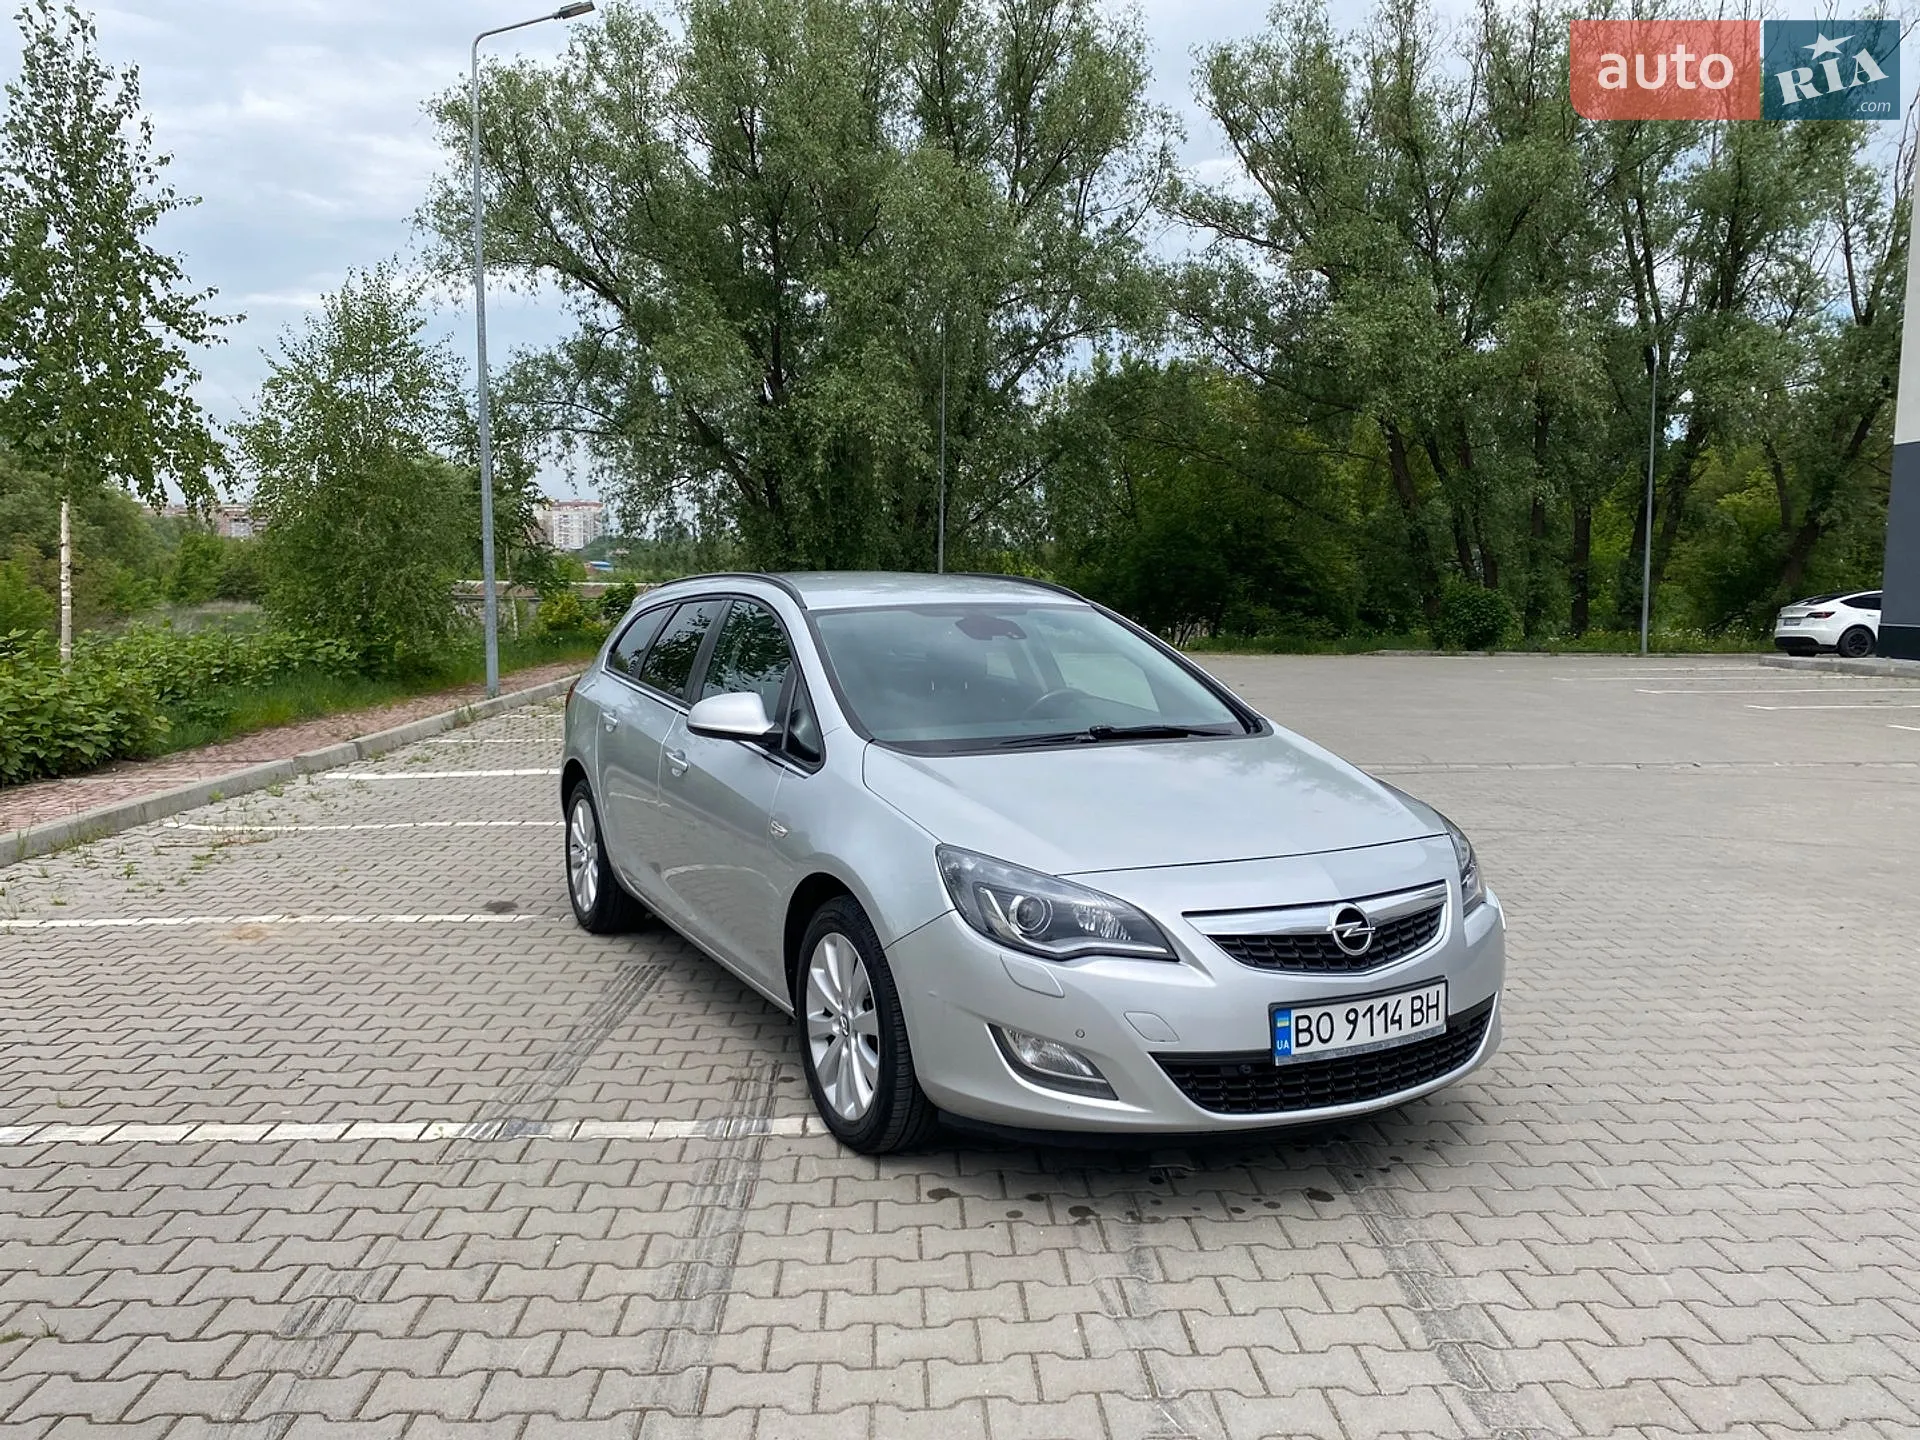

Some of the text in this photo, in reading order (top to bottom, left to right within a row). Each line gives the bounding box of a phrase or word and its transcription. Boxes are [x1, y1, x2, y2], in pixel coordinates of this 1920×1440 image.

[1295, 990, 1440, 1048] BO 9114 BH
[1276, 1040, 1291, 1051] UA
